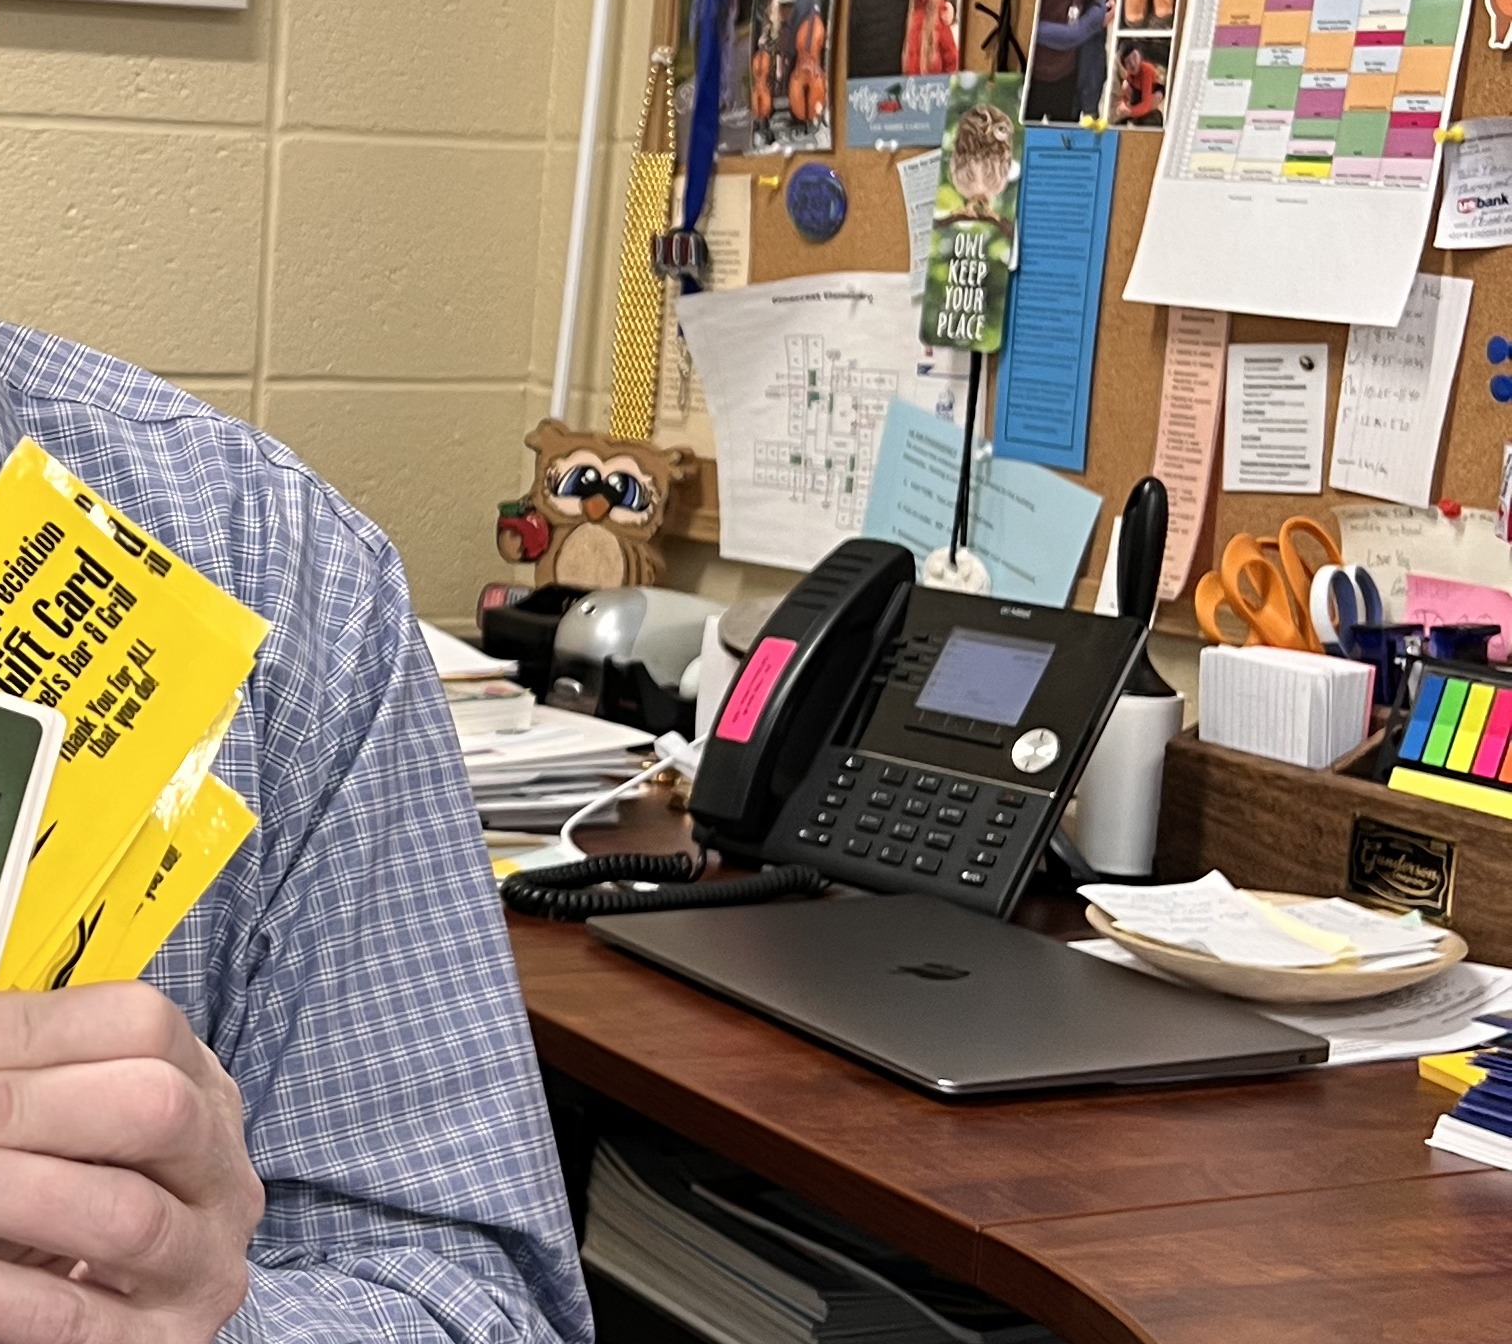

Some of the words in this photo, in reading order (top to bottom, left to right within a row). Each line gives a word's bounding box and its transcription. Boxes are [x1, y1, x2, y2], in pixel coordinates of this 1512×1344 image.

[954, 232, 987, 259] OWL
[948, 258, 988, 287] KEEP
[944, 285, 985, 312] YOUR
[937, 312, 986, 342] PLACE
[32, 546, 115, 639] Card
[94, 582, 138, 629] Grill
[83, 621, 107, 645] &
[56, 640, 94, 678] Bar
[85, 689, 118, 719] You
[107, 664, 132, 693] for
[126, 638, 156, 671] ALL
[88, 725, 121, 759] that
[114, 697, 142, 731] you
